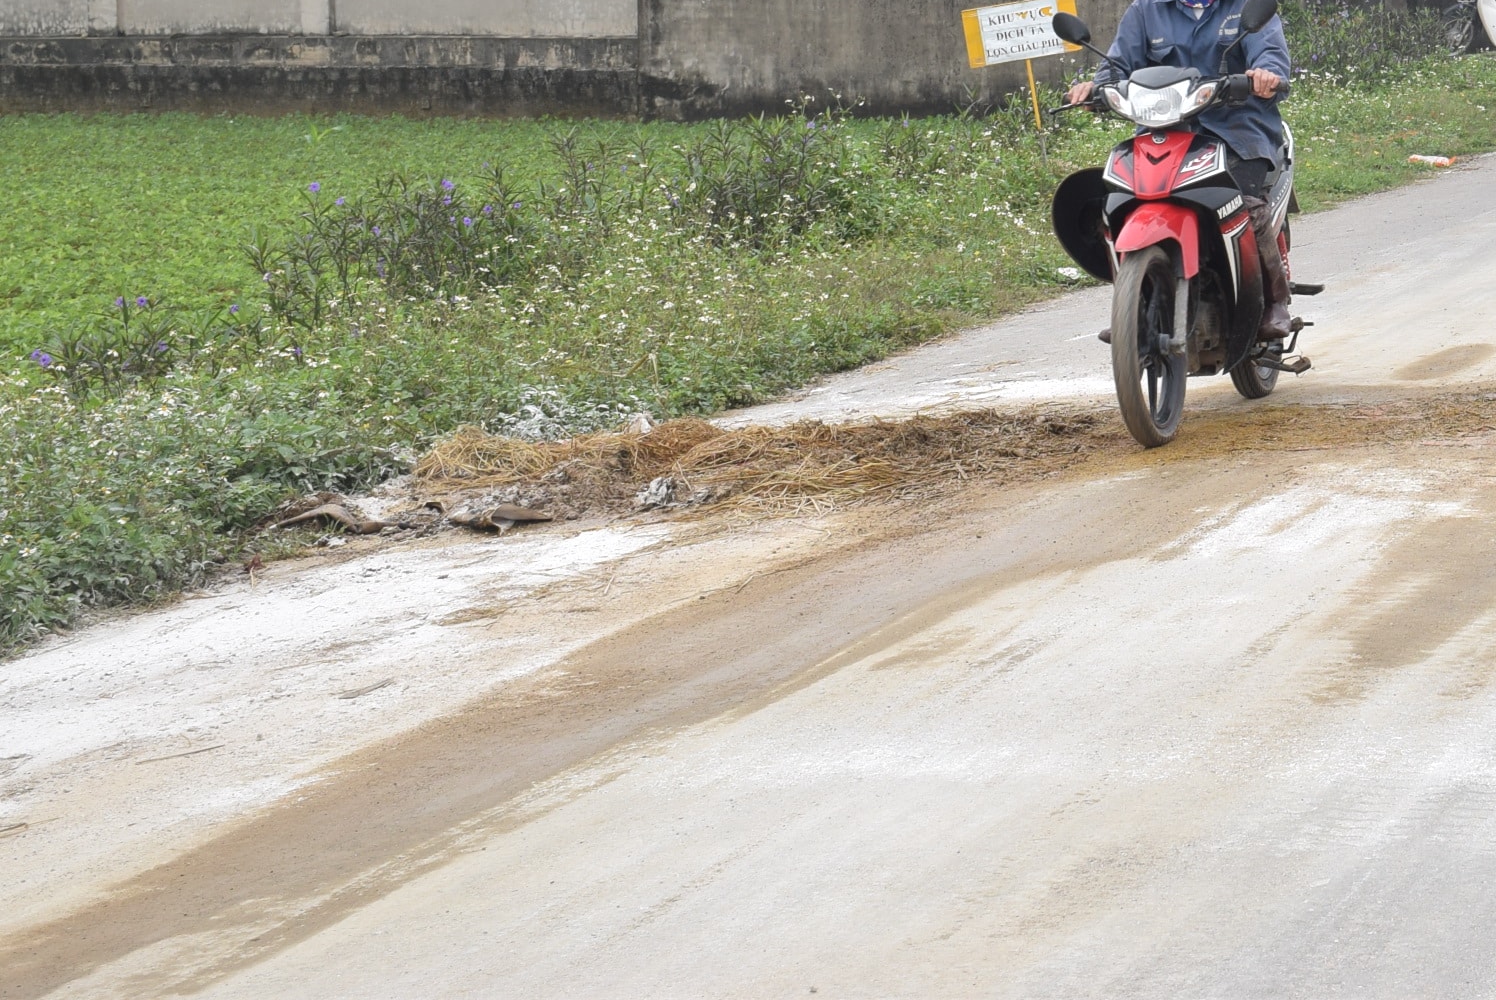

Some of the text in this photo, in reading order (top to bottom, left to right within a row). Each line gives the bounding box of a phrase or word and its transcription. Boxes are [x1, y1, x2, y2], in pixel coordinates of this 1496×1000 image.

[988, 14, 1014, 26] KHU
[996, 29, 1024, 41] DỊCH
[986, 38, 1060, 58] LỢN CHÂU PHI
[1217, 195, 1243, 219] YAMAHA
